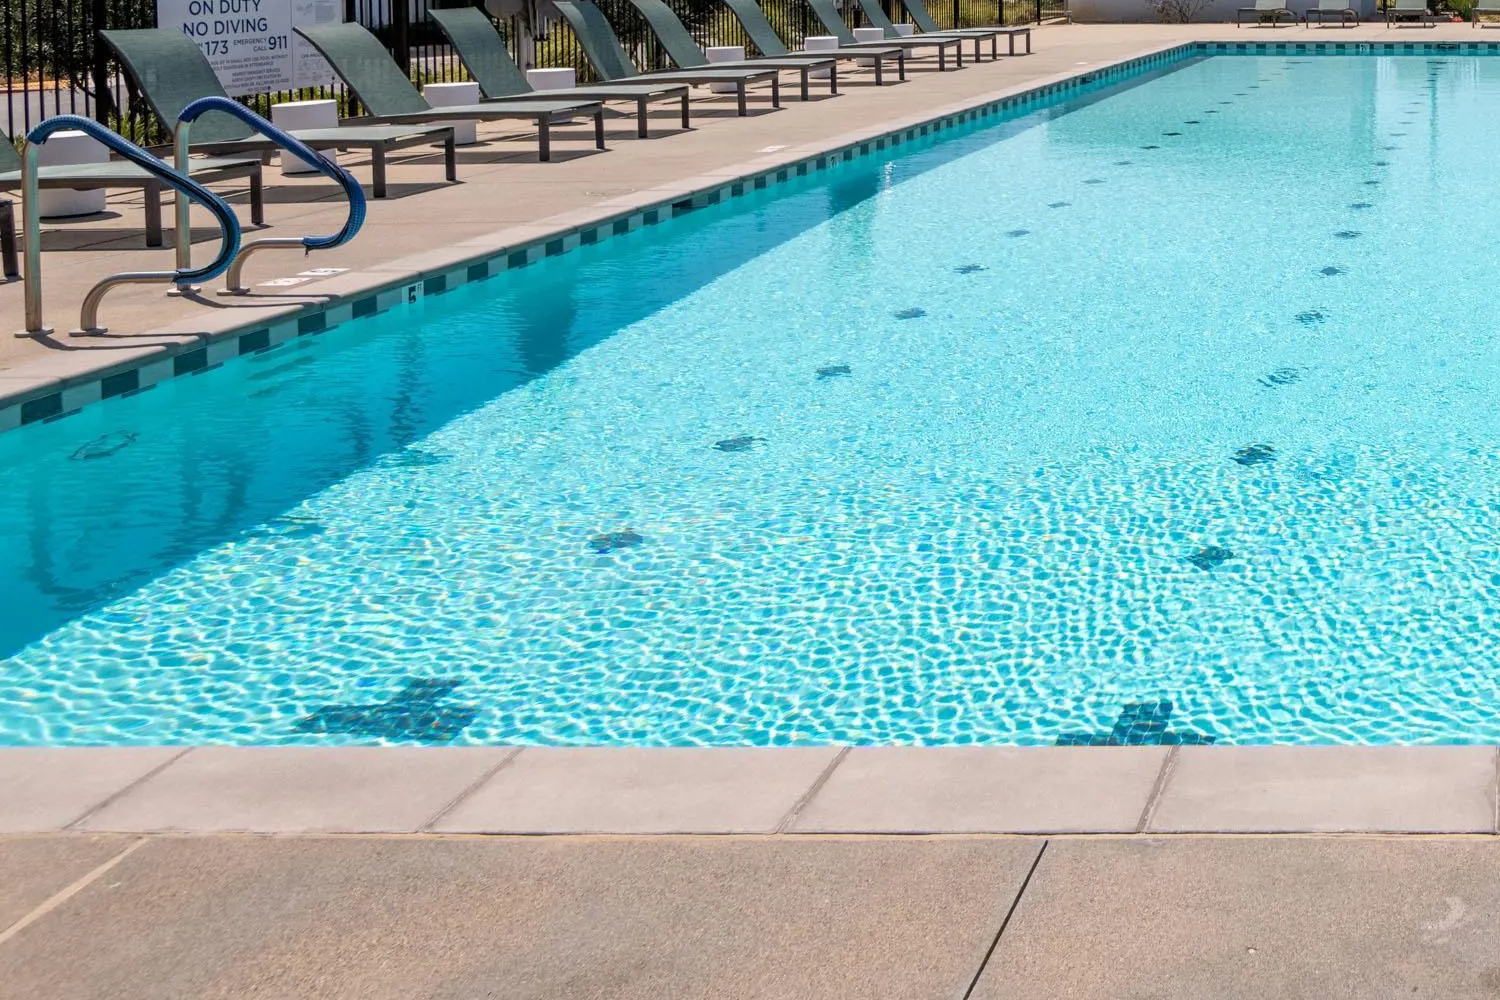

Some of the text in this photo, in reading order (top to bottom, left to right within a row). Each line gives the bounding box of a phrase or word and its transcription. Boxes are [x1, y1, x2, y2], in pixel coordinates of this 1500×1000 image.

[188, 0, 214, 16] ON
[183, 18, 268, 37] NO DIVING
[205, 40, 229, 56] 173
[233, 38, 267, 46] EMERGENCY
[268, 36, 288, 50] 911
